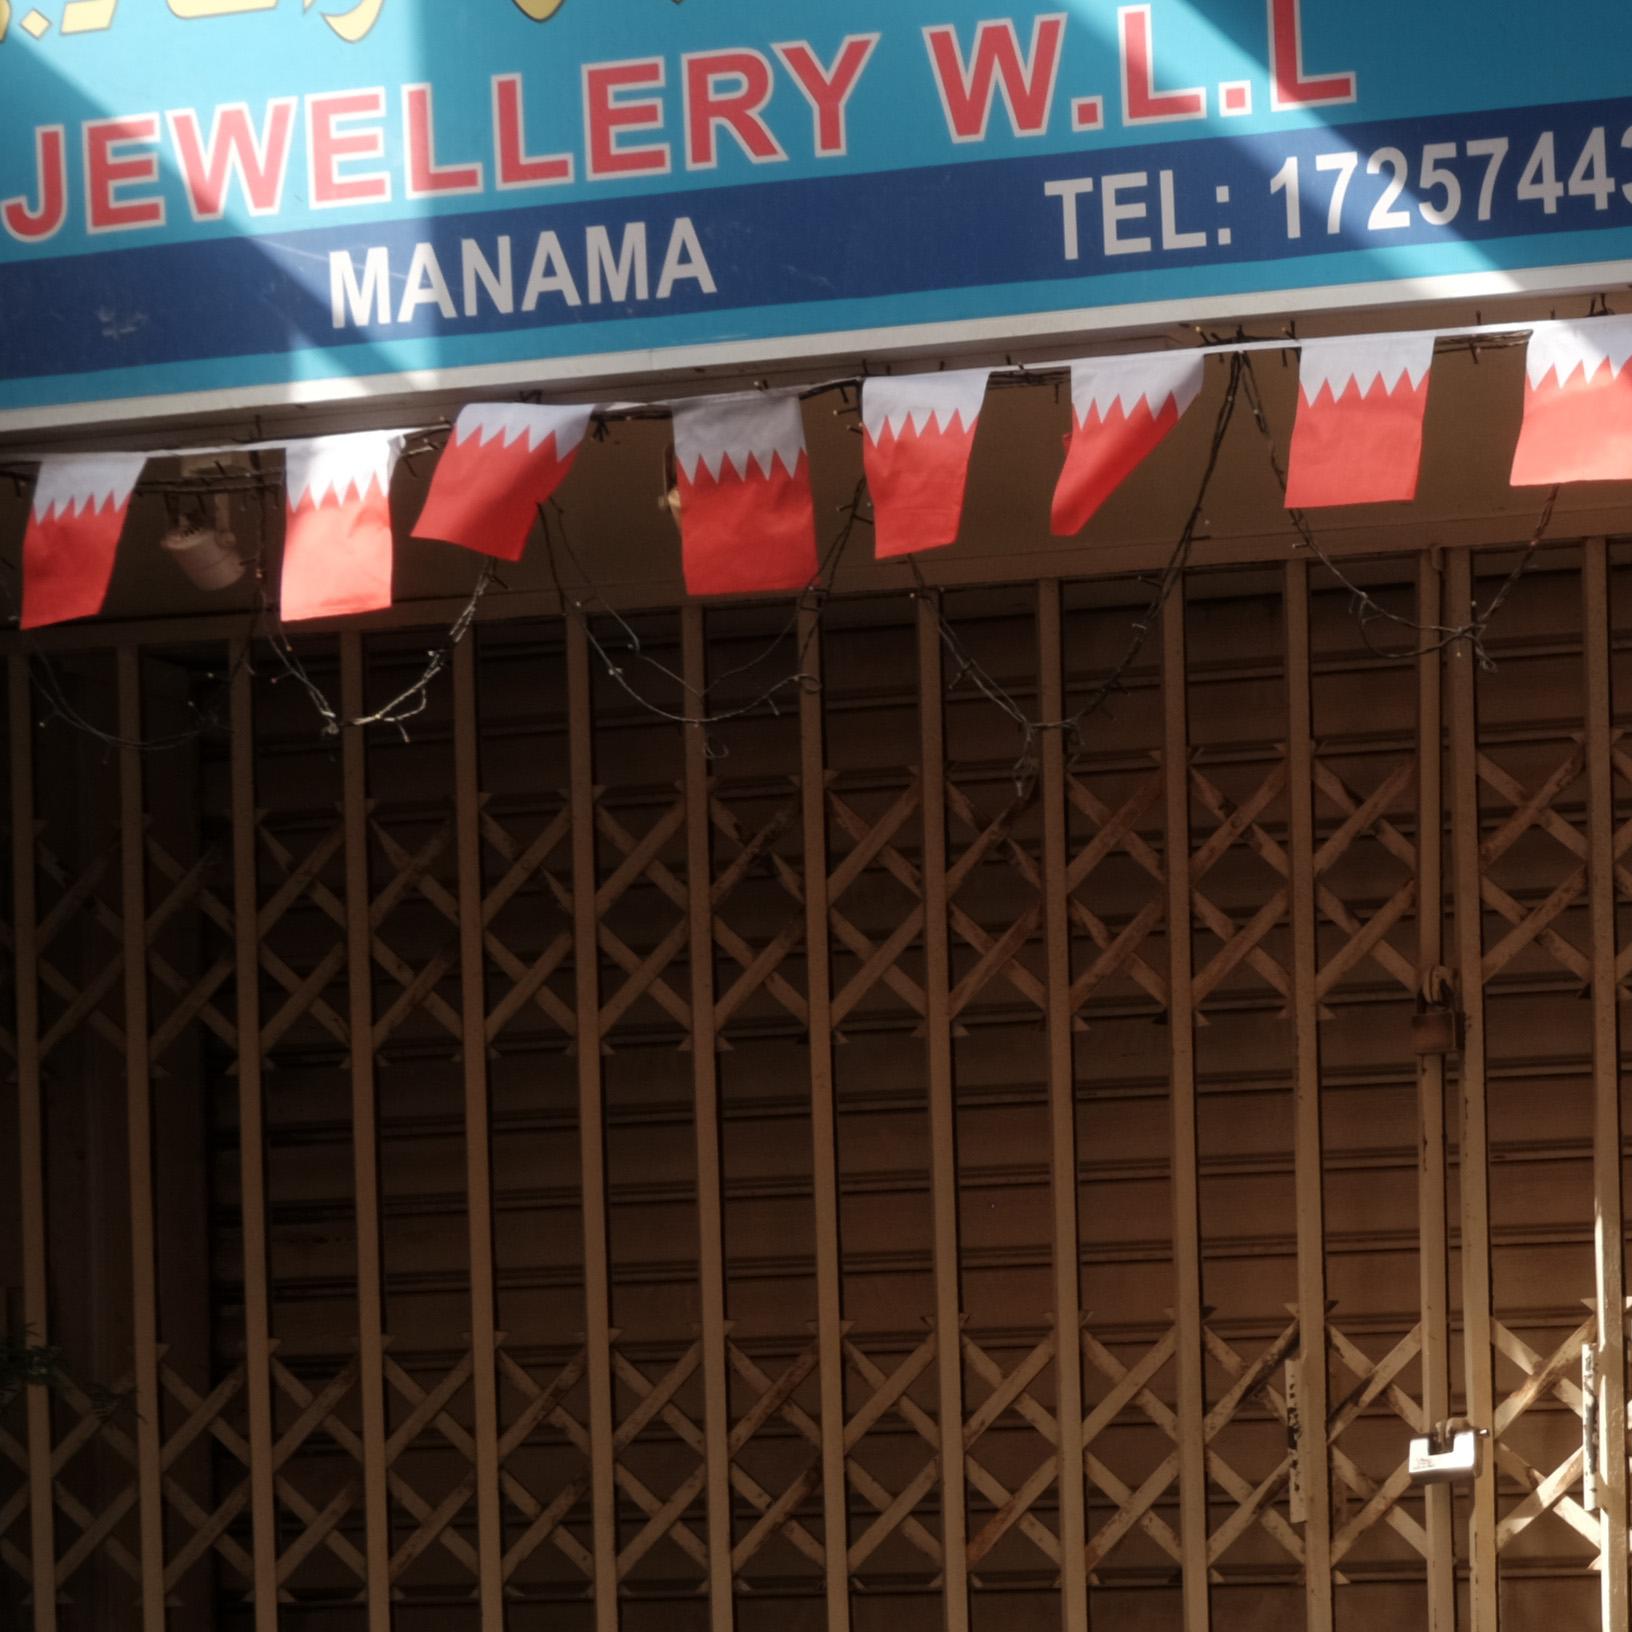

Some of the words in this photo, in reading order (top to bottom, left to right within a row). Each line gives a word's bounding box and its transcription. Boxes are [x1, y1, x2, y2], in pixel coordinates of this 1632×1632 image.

[2, 33, 881, 242] JEWELLERY
[329, 217, 718, 330] MANAMA
[1043, 169, 1232, 260] TEL:
